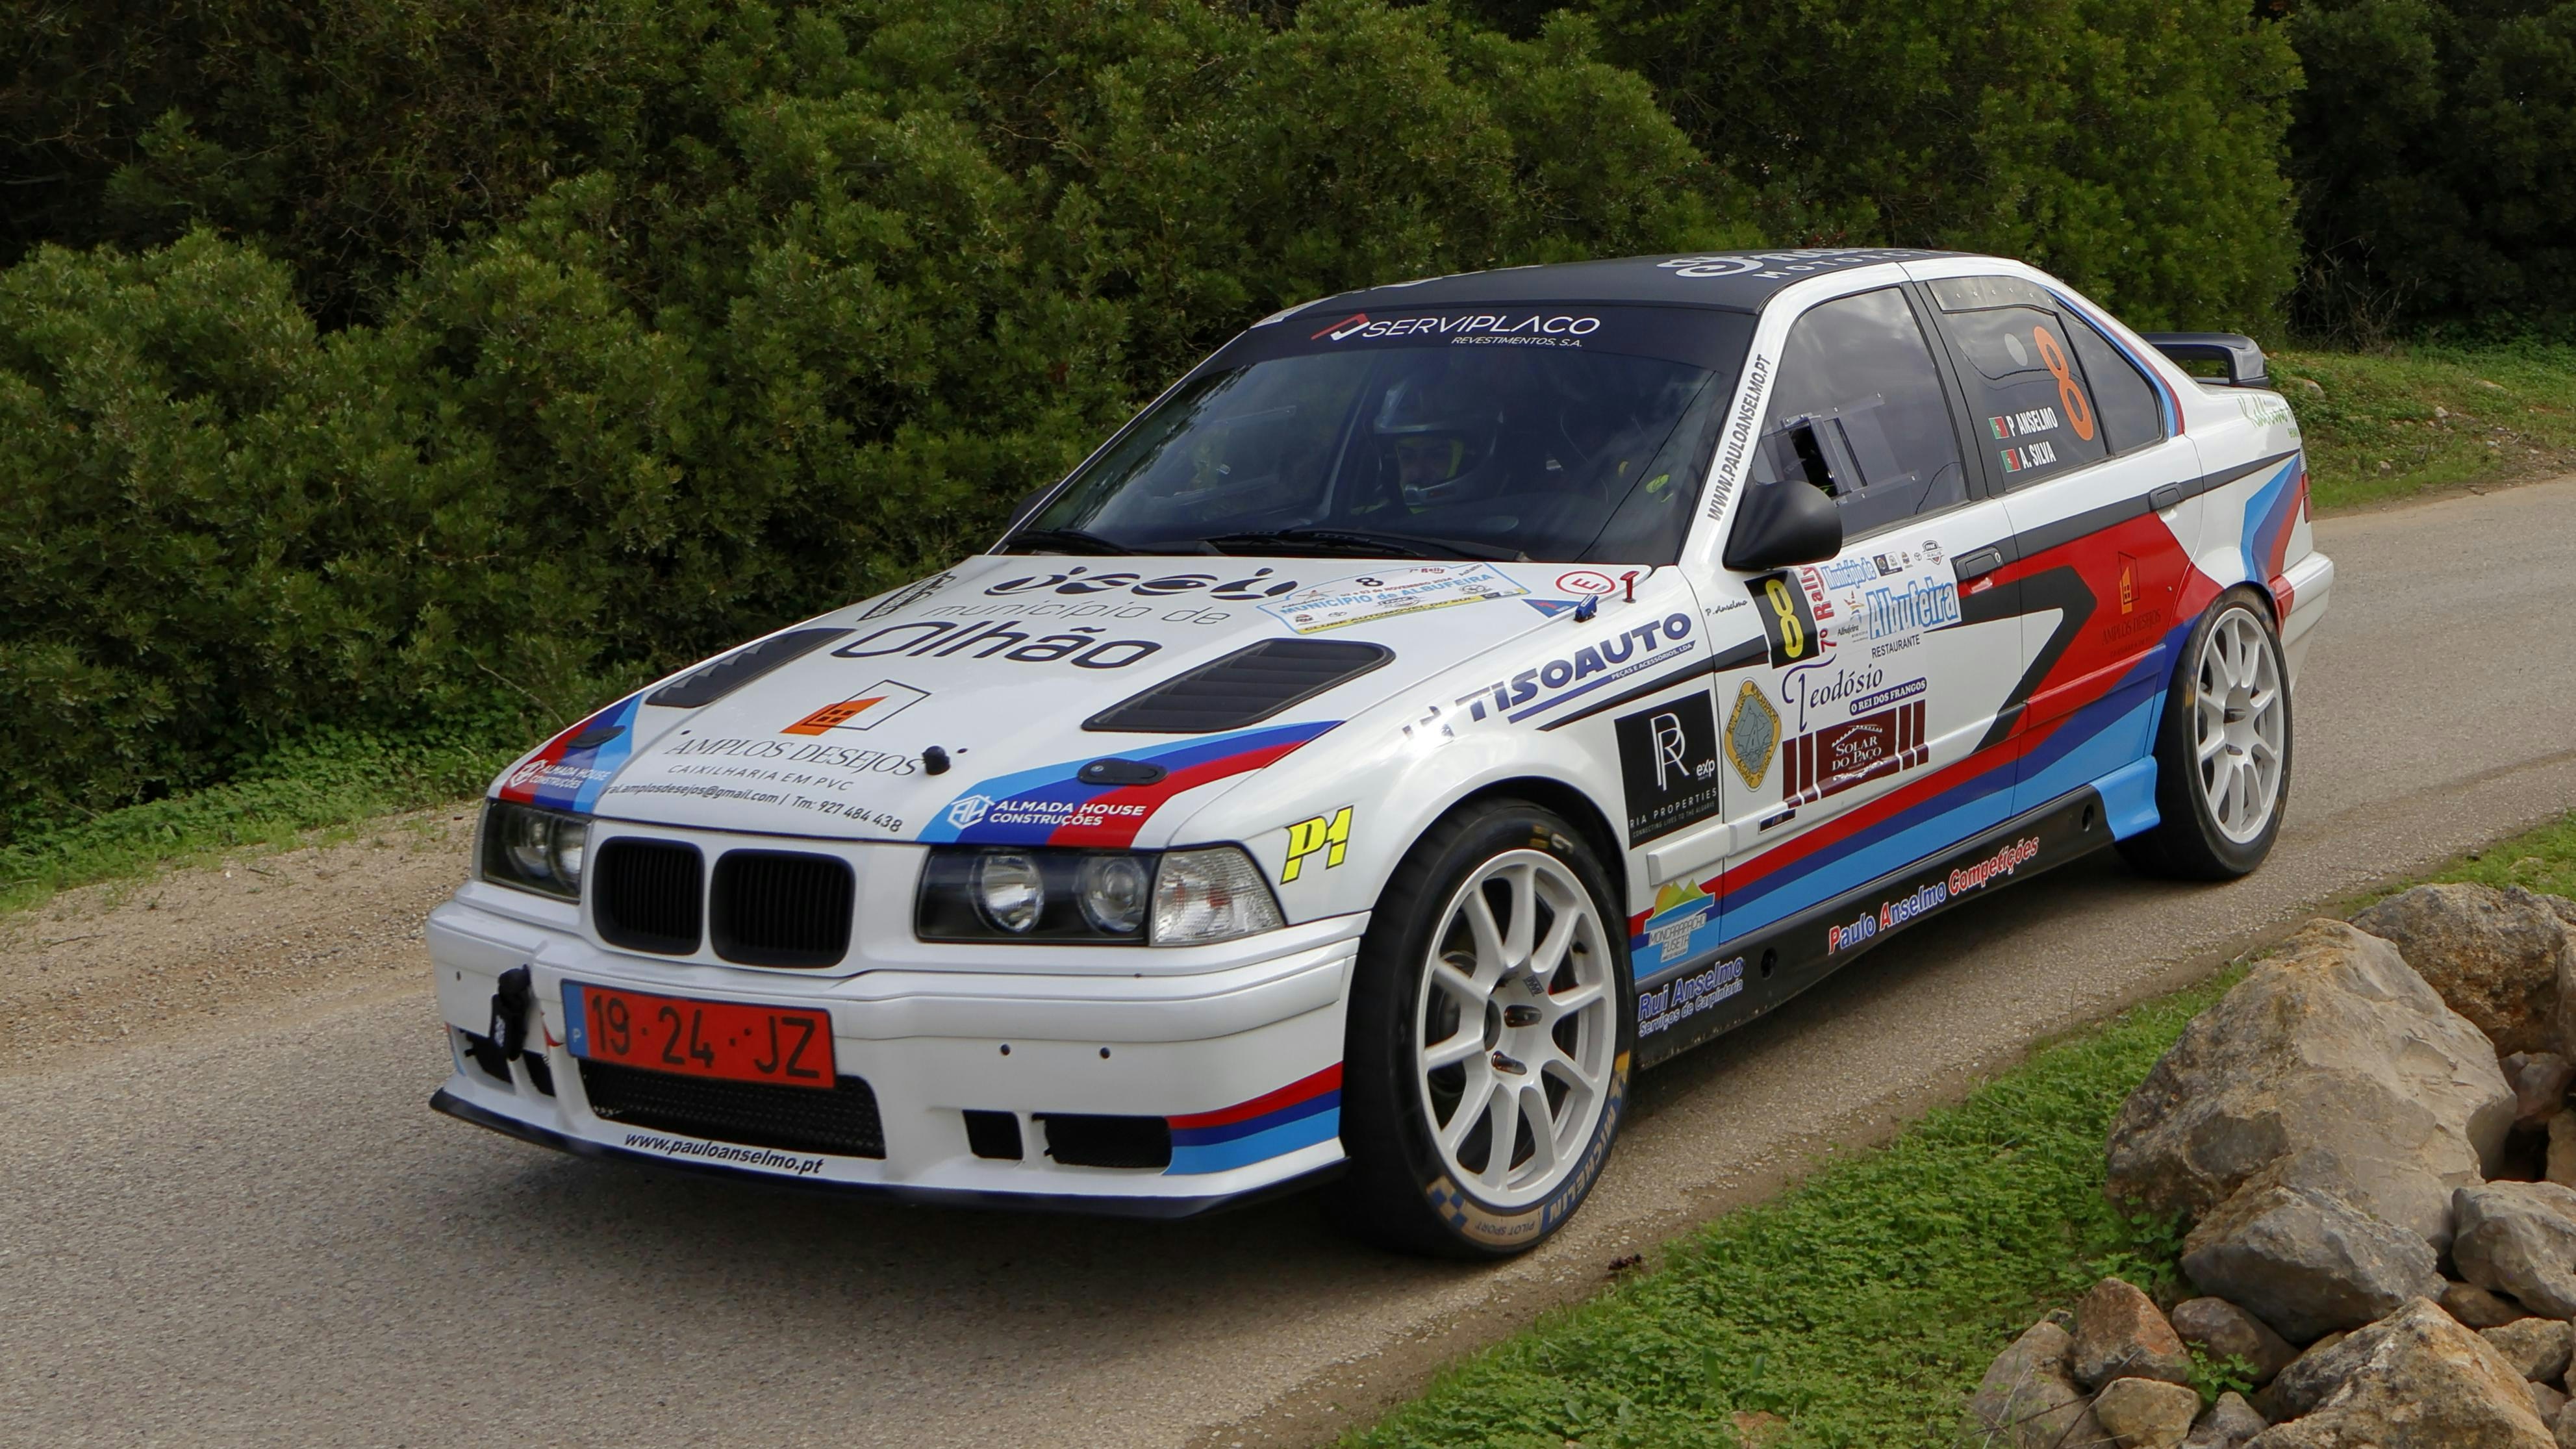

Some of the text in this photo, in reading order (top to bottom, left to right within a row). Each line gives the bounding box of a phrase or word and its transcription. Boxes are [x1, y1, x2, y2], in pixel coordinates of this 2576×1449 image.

[1362, 316, 1600, 338] SERVIPLACO
[1559, 338, 1583, 347] S.A.
[2033, 326, 2094, 441] 8
[2015, 407, 2058, 435] ANSELMO
[1707, 354, 1771, 521] WWW.PAULOANSELMO.PT
[2019, 441, 2056, 469] A. SILVA
[1355, 577, 1384, 586] 8
[1571, 578, 1600, 590] E
[1820, 557, 1876, 590] Município de
[1279, 594, 1372, 614] MUNICÍPIO
[1378, 590, 1398, 600] de
[1402, 573, 1495, 596] ALBUFEIRA
[1715, 599, 1748, 614] Anselmo
[1799, 566, 1835, 621] Rally
[1865, 575, 1958, 640] Albufeira
[919, 599, 1231, 625] município de
[1765, 579, 1804, 659] 8
[830, 620, 1163, 669] Olhão
[1871, 635, 1921, 659] RESTAURANTE
[1611, 668, 1633, 680] PEÇAS
[1782, 653, 1883, 733] Teodósio
[1851, 681, 1926, 712] O REI DOS FRANGOS
[663, 738, 925, 776] AMPLOS DESEJOS
[1832, 757, 1850, 771] DO
[1853, 747, 1882, 764] PAÇO
[1836, 736, 1878, 757] SOLAR
[529, 774, 583, 789] CONSTRUÇÕES
[539, 764, 612, 781] ALMADA HOUSE
[667, 764, 855, 792] CAIXILHARIA EM PVC
[1696, 759, 1715, 777] exp
[792, 795, 817, 810] Tm:
[819, 800, 844, 816] 927
[844, 806, 870, 824] 484
[873, 814, 903, 833] 438
[989, 813, 1103, 827] CONSTRUÇÕES
[993, 800, 1147, 816] ALMADA HOUSE
[1630, 787, 1717, 829] RIA PROPERTIES
[1686, 809, 1695, 817] THE
[1280, 805, 1354, 885] P1
[1828, 837, 2039, 955] Paulo Anselmo Competições
[1637, 956, 1744, 1022] Rui Anselmo
[1639, 978, 1743, 1038] Serviços de Carpintaria
[572, 1027, 582, 1042] P
[624, 1133, 824, 1175] www.pauloanselmo.pt
[1548, 1105, 1616, 1224] MICHELIN
[1508, 1221, 1535, 1235] PILOT
